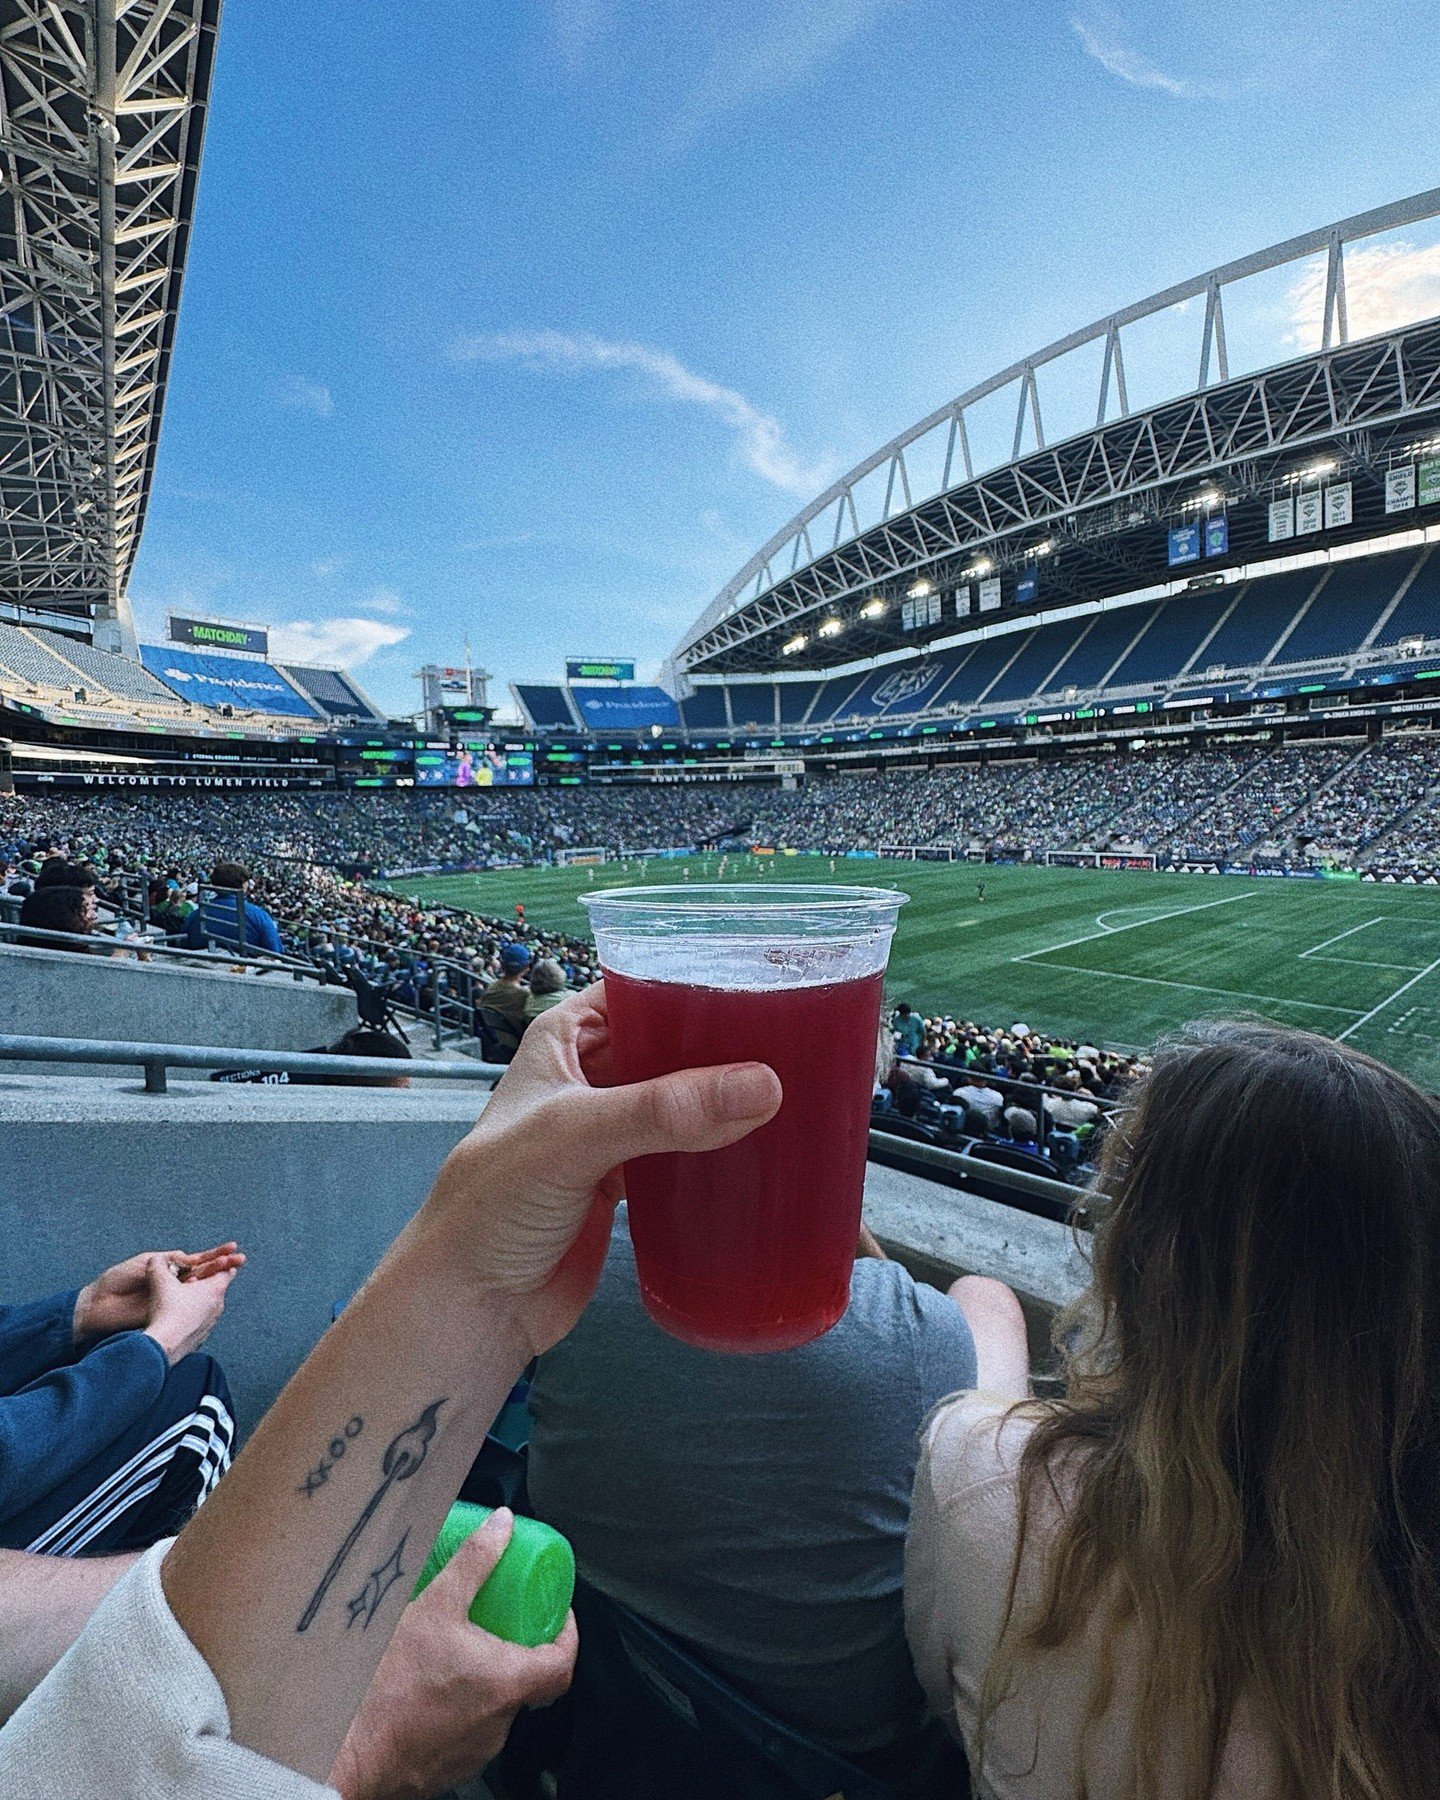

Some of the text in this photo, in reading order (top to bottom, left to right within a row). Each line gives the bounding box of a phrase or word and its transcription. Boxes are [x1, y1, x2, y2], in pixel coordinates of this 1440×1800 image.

[192, 625, 248, 645] MATCHDAY
[83, 774, 289, 787] WELCOME TO LUMEN FIELD
[261, 1071, 290, 1085] 104
